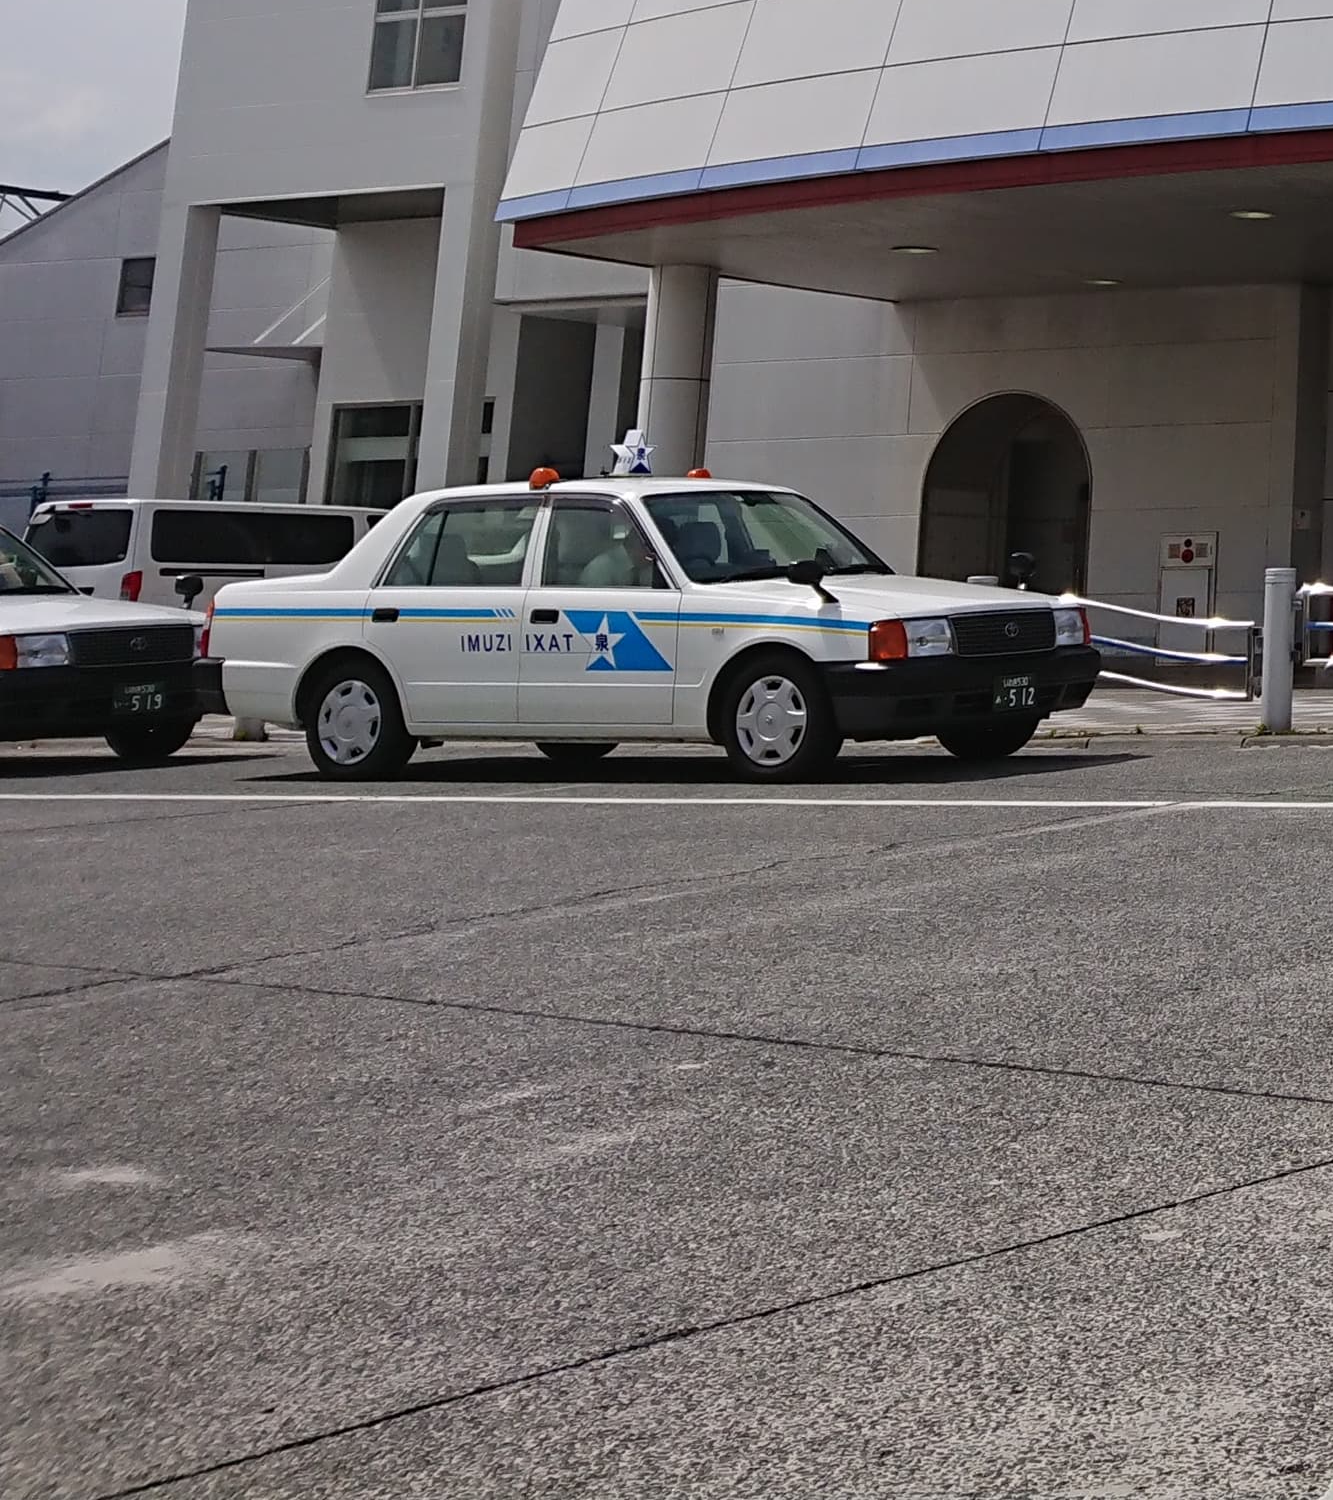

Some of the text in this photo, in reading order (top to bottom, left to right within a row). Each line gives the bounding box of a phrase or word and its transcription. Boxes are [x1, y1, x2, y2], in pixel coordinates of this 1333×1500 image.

[461, 634, 574, 652] IMUZI IXAT
[595, 634, 609, 651] 泉
